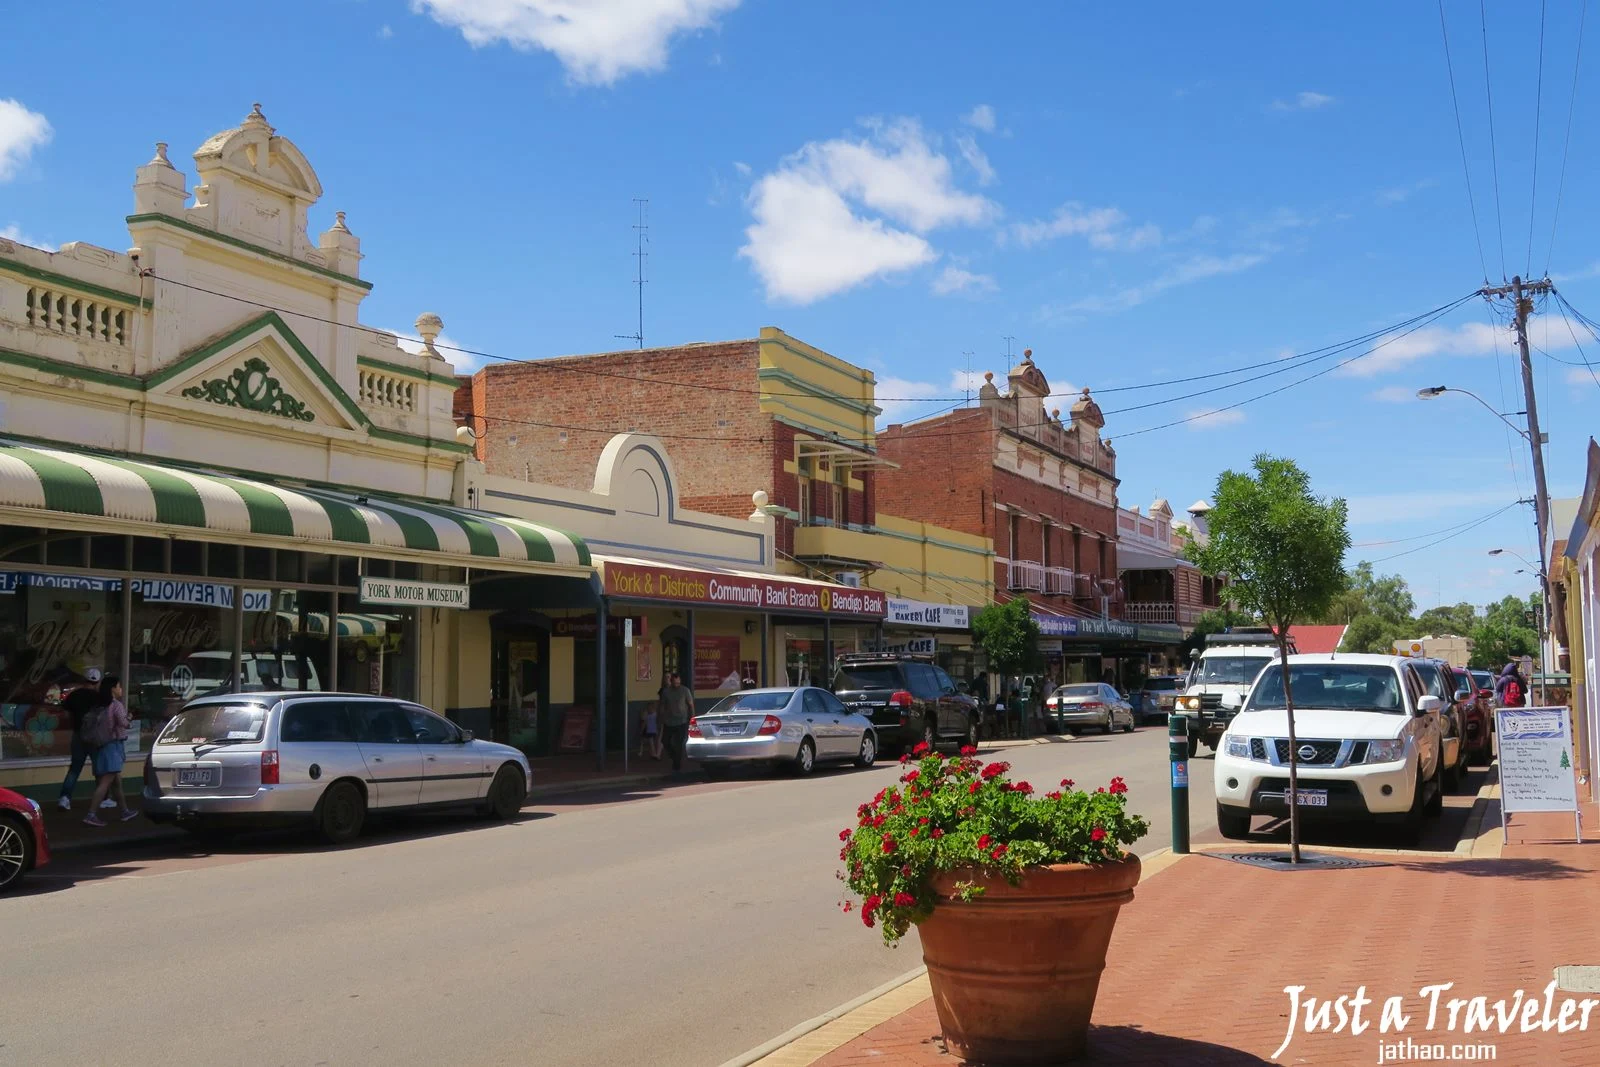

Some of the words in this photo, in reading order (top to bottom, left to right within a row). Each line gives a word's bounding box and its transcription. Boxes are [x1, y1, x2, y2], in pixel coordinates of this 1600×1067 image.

[367, 583, 391, 598] YORK
[394, 585, 424, 601] MOTOR
[427, 588, 463, 603] MUSEUM
[611, 570, 641, 592] York
[644, 573, 653, 594] &
[659, 575, 705, 598] Districts
[709, 579, 762, 606] Community
[766, 586, 788, 605] Bank
[789, 588, 819, 607] Branch
[832, 592, 862, 612] Bendigo
[864, 595, 882, 612] Bank
[895, 611, 923, 622] BAKERY
[925, 607, 940, 623] CAFE
[1081, 620, 1092, 632] The
[1093, 621, 1105, 633] York
[1106, 622, 1134, 637] Newsagency
[908, 640, 932, 652] CAFE
[1288, 795, 1308, 805] 1GX
[1312, 796, 1326, 805] 033
